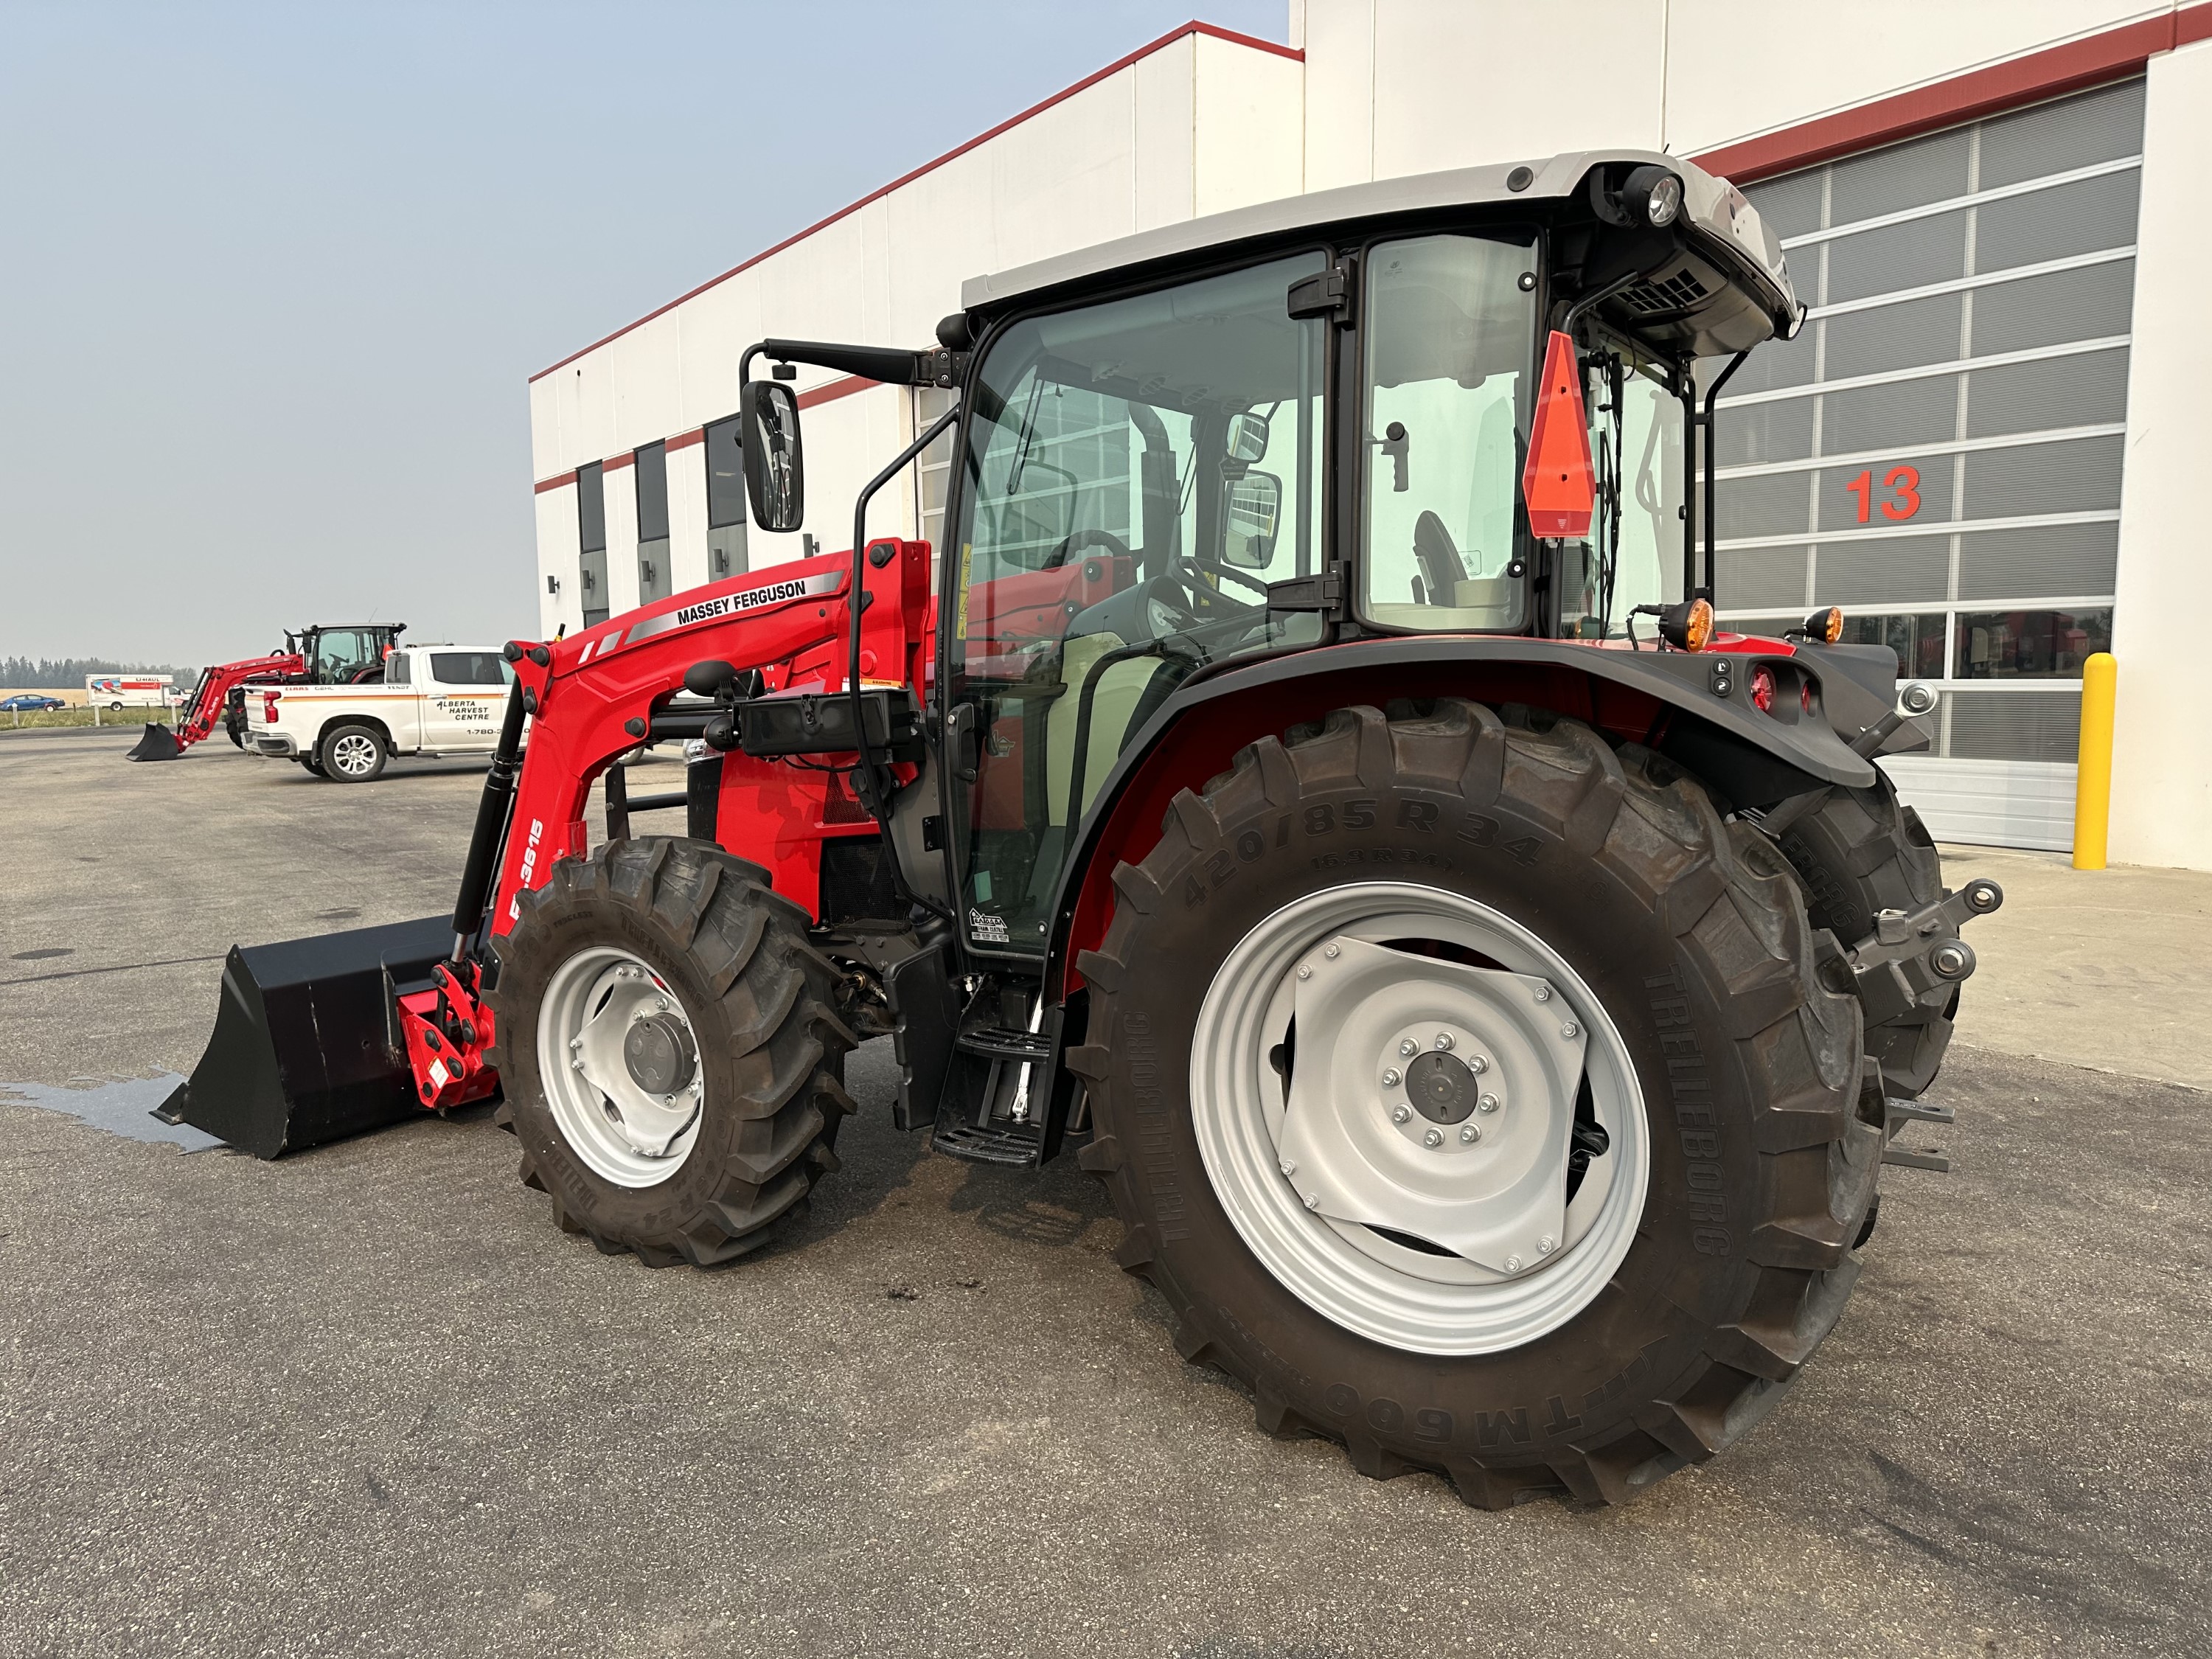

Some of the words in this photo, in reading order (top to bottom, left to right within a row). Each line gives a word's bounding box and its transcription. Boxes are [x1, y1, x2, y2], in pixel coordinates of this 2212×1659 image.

[1846, 465, 1920, 523] 13
[677, 597, 730, 625] MASSEY
[734, 580, 806, 611] FERGUSON
[437, 700, 476, 710] ALBERTA
[1184, 798, 1378, 911] 420/85
[1394, 797, 1440, 834] R
[1455, 810, 1545, 868] 34
[553, 911, 593, 928] TUBELESS
[1123, 1011, 1192, 1249] TRELLEBORG
[1642, 962, 1734, 1258] TRELLEBORG
[524, 1120, 599, 1214] TRELLEBORG
[643, 1207, 673, 1231] 24
[1218, 1306, 1312, 1388] TUBELESS
[1324, 1381, 1454, 1445] 600
[1474, 1394, 1583, 1449] TM
